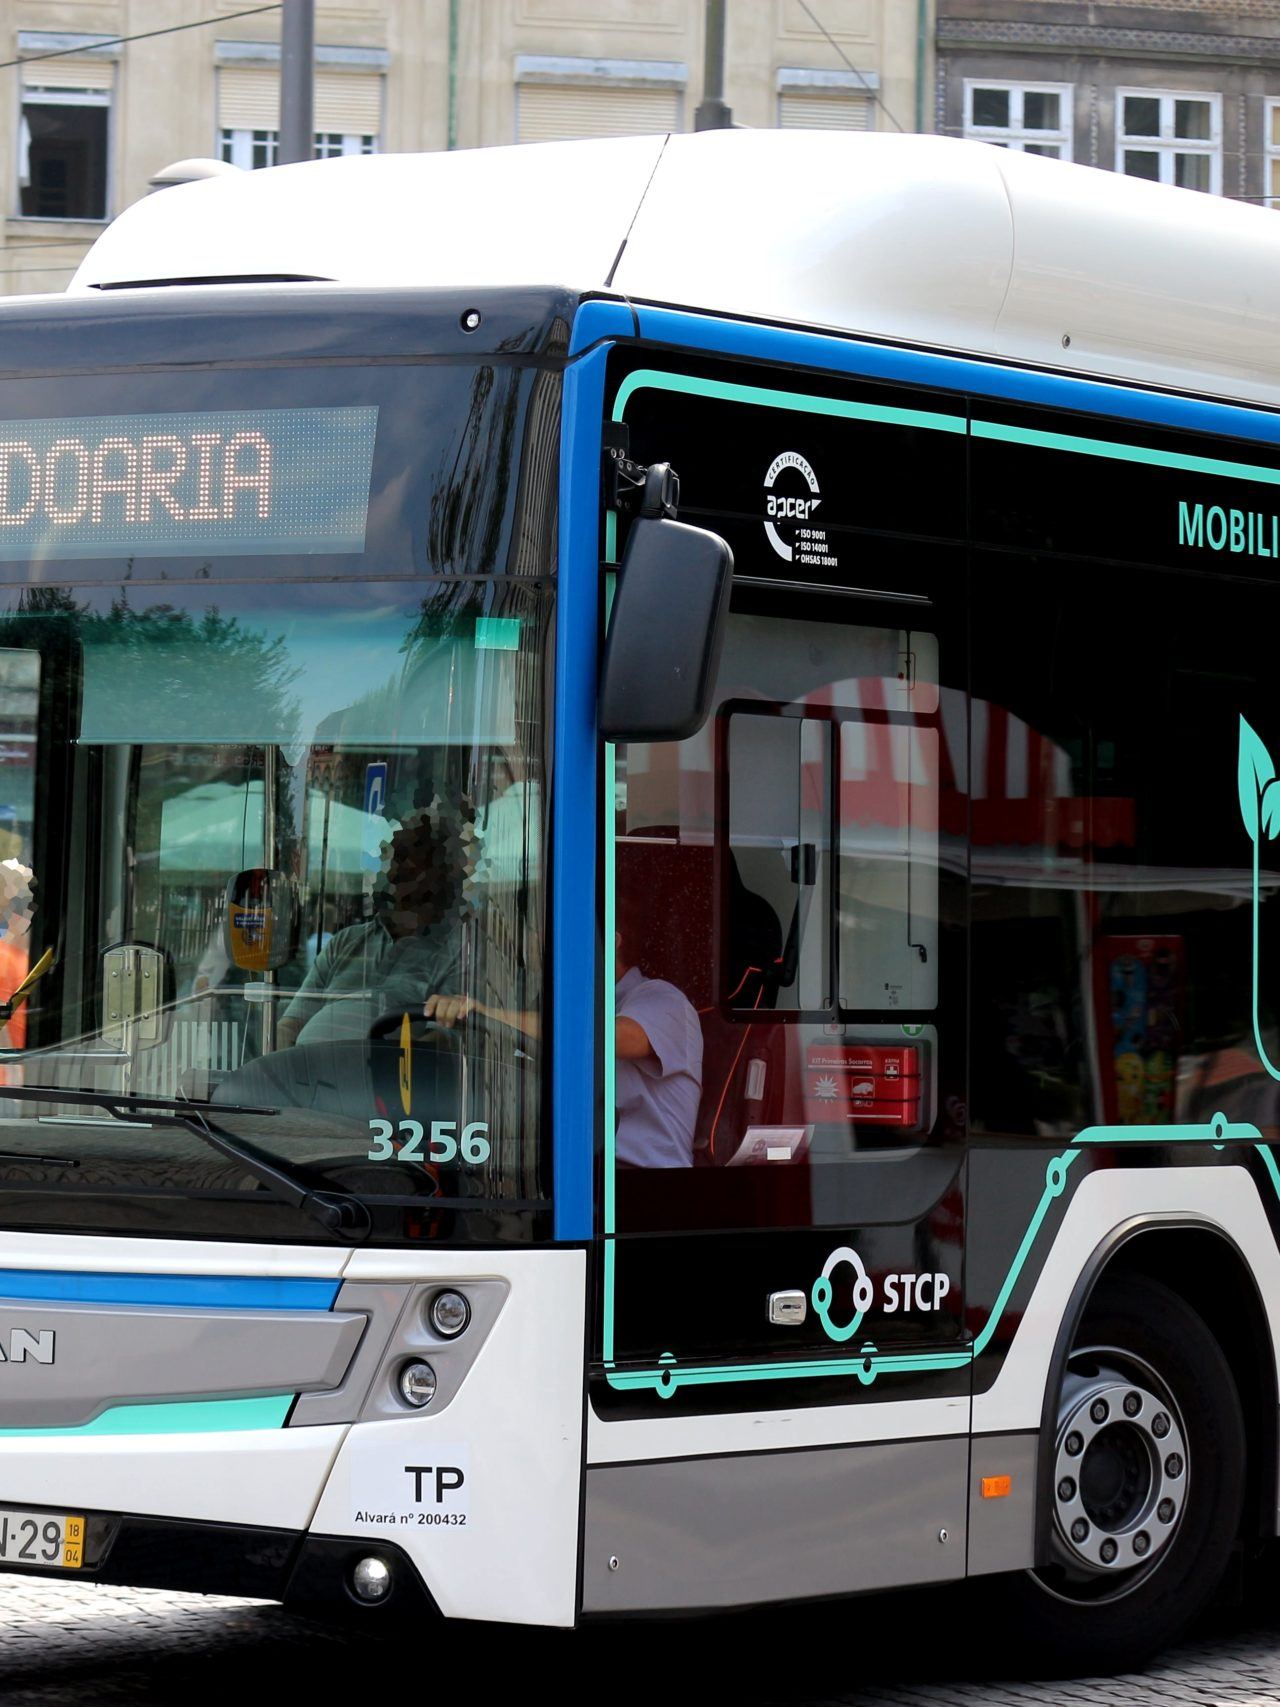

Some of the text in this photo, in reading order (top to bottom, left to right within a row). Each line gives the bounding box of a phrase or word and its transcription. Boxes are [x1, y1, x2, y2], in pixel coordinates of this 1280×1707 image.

[766, 495, 812, 522] apcer
[800, 528, 826, 541] ISO 9001
[800, 541, 829, 554] ISO 14001
[800, 553, 838, 567] OHSAS 18001
[367, 1118, 491, 1165] 3256
[883, 1273, 950, 1313] STCP
[404, 1466, 465, 1503] TP
[355, 1511, 396, 1524] Alvará
[417, 1513, 467, 1526] 200432
[68, 1524, 80, 1538] 18
[65, 1549, 79, 1563] 04
